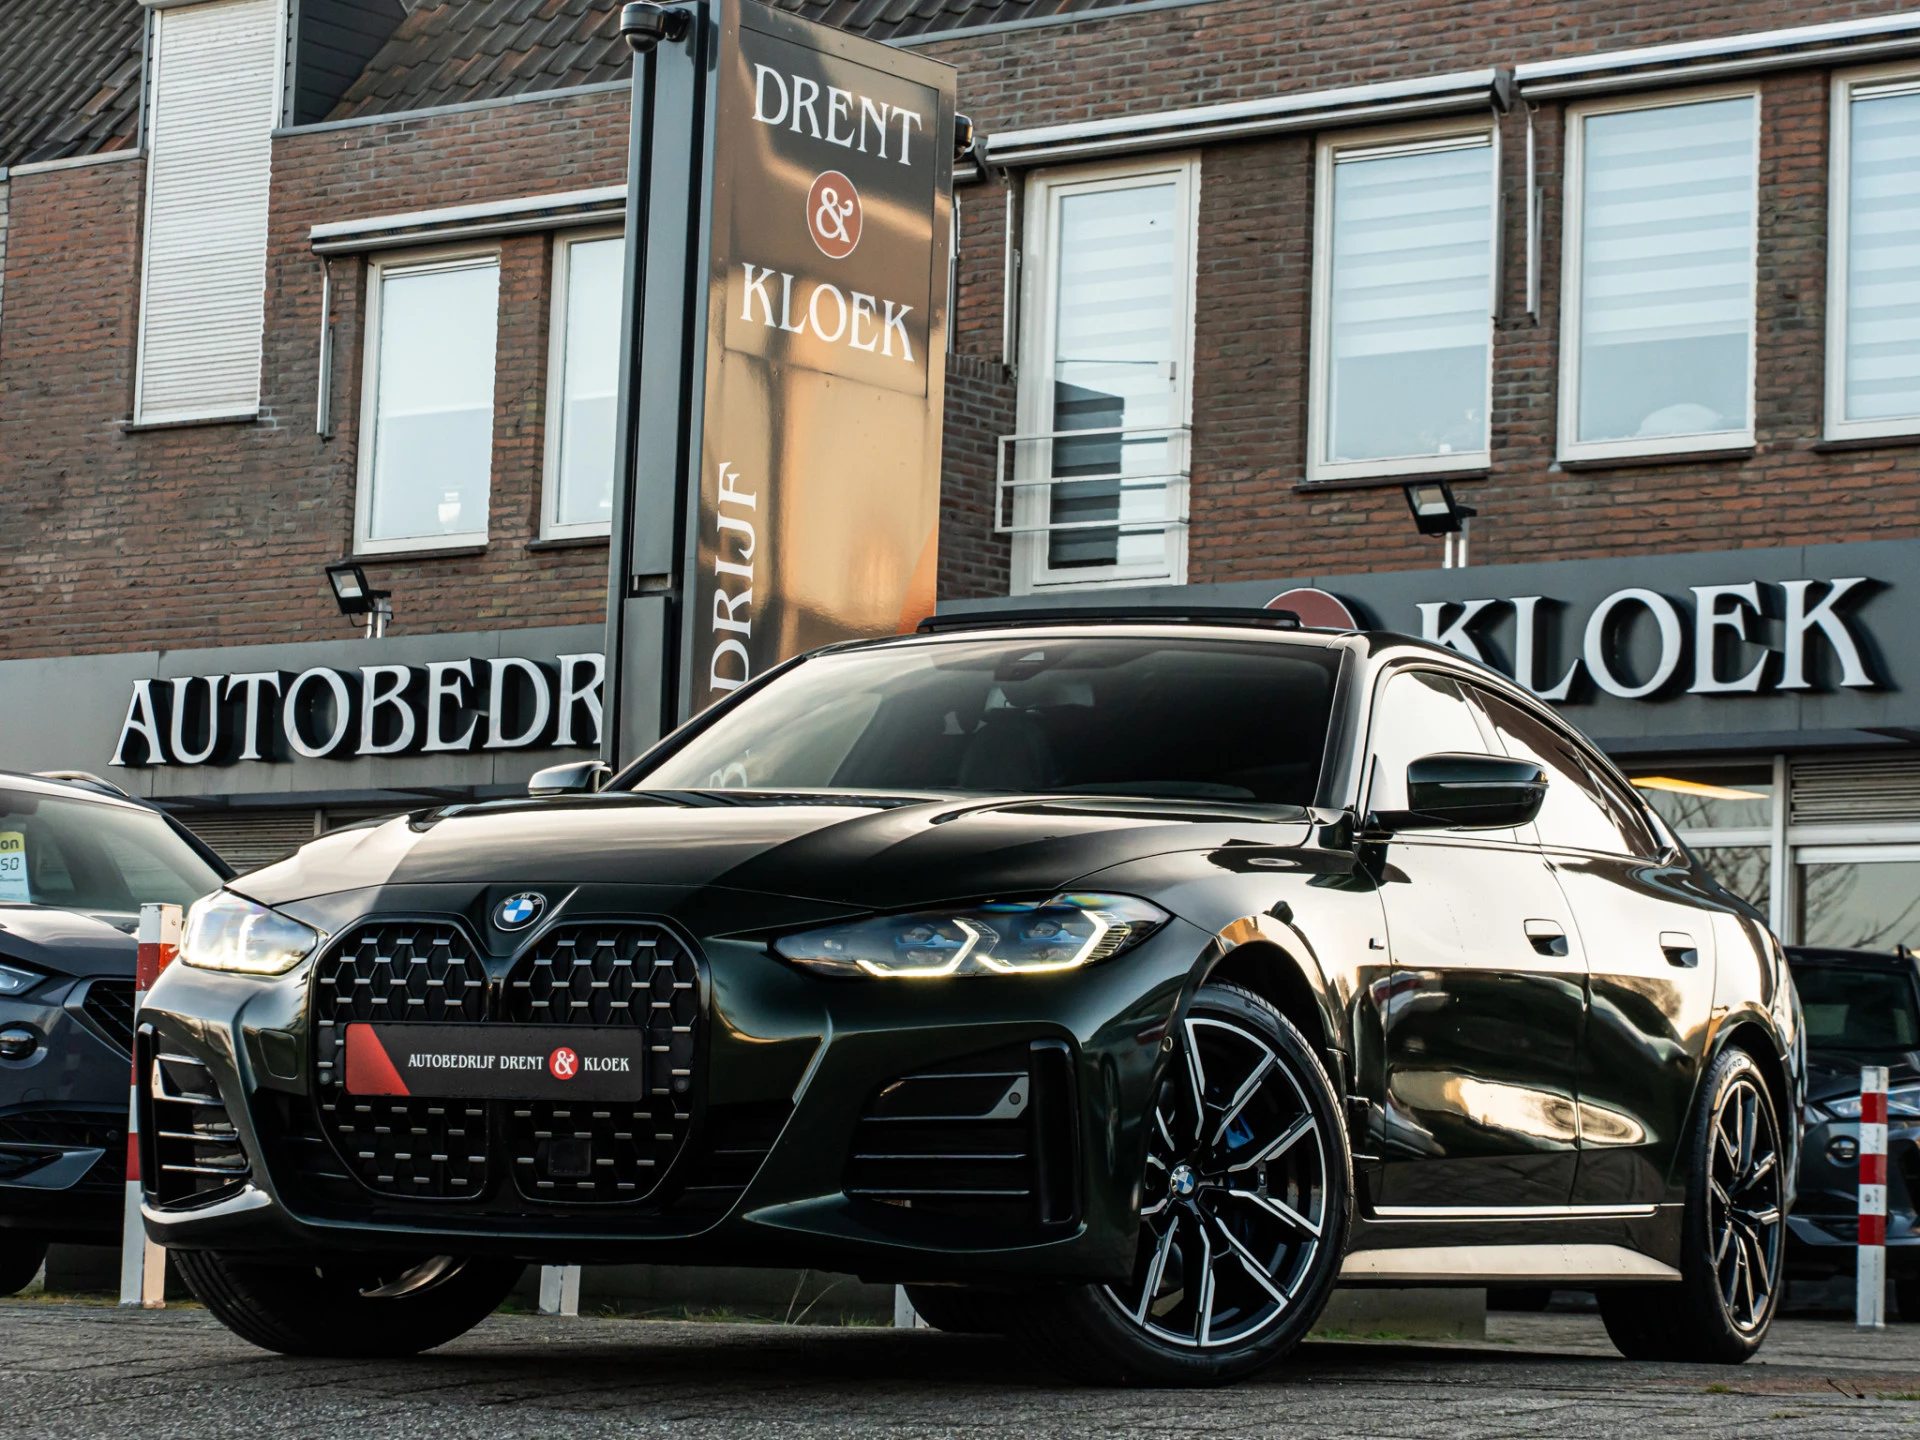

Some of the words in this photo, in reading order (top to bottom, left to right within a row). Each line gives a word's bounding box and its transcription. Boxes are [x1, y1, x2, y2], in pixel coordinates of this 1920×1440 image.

[751, 62, 923, 166] DRENT
[815, 186, 854, 243] &
[740, 262, 915, 362] KLOEK
[107, 652, 606, 767] AUTOBEDR
[408, 1053, 496, 1069] AUTOBEDRIJF
[500, 1056, 544, 1070] DRENT
[554, 1050, 575, 1075] &
[584, 1057, 630, 1072] KLOEK
